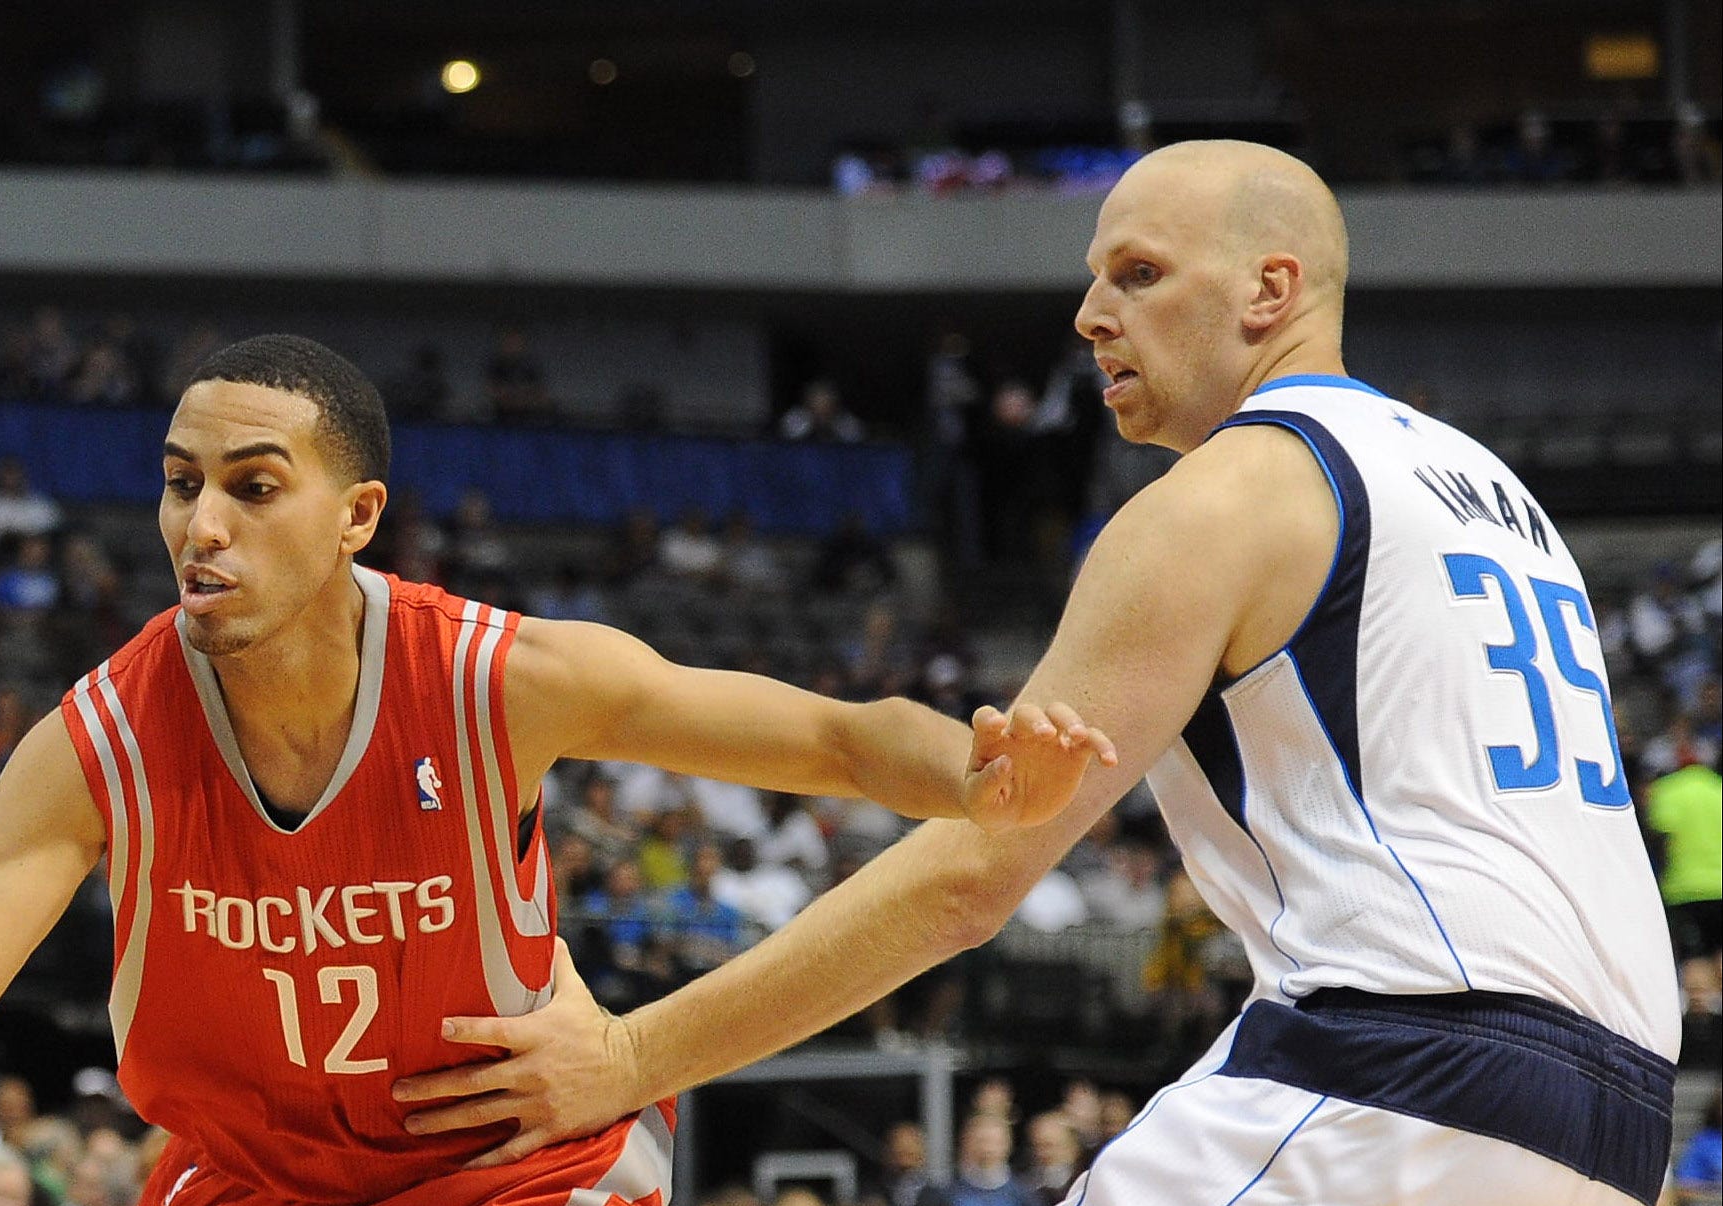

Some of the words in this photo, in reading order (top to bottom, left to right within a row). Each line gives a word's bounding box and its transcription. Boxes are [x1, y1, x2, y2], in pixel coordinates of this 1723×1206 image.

[1441, 552, 1633, 811] 35
[168, 875, 456, 956] ROCKETS
[263, 966, 389, 1075] 12
